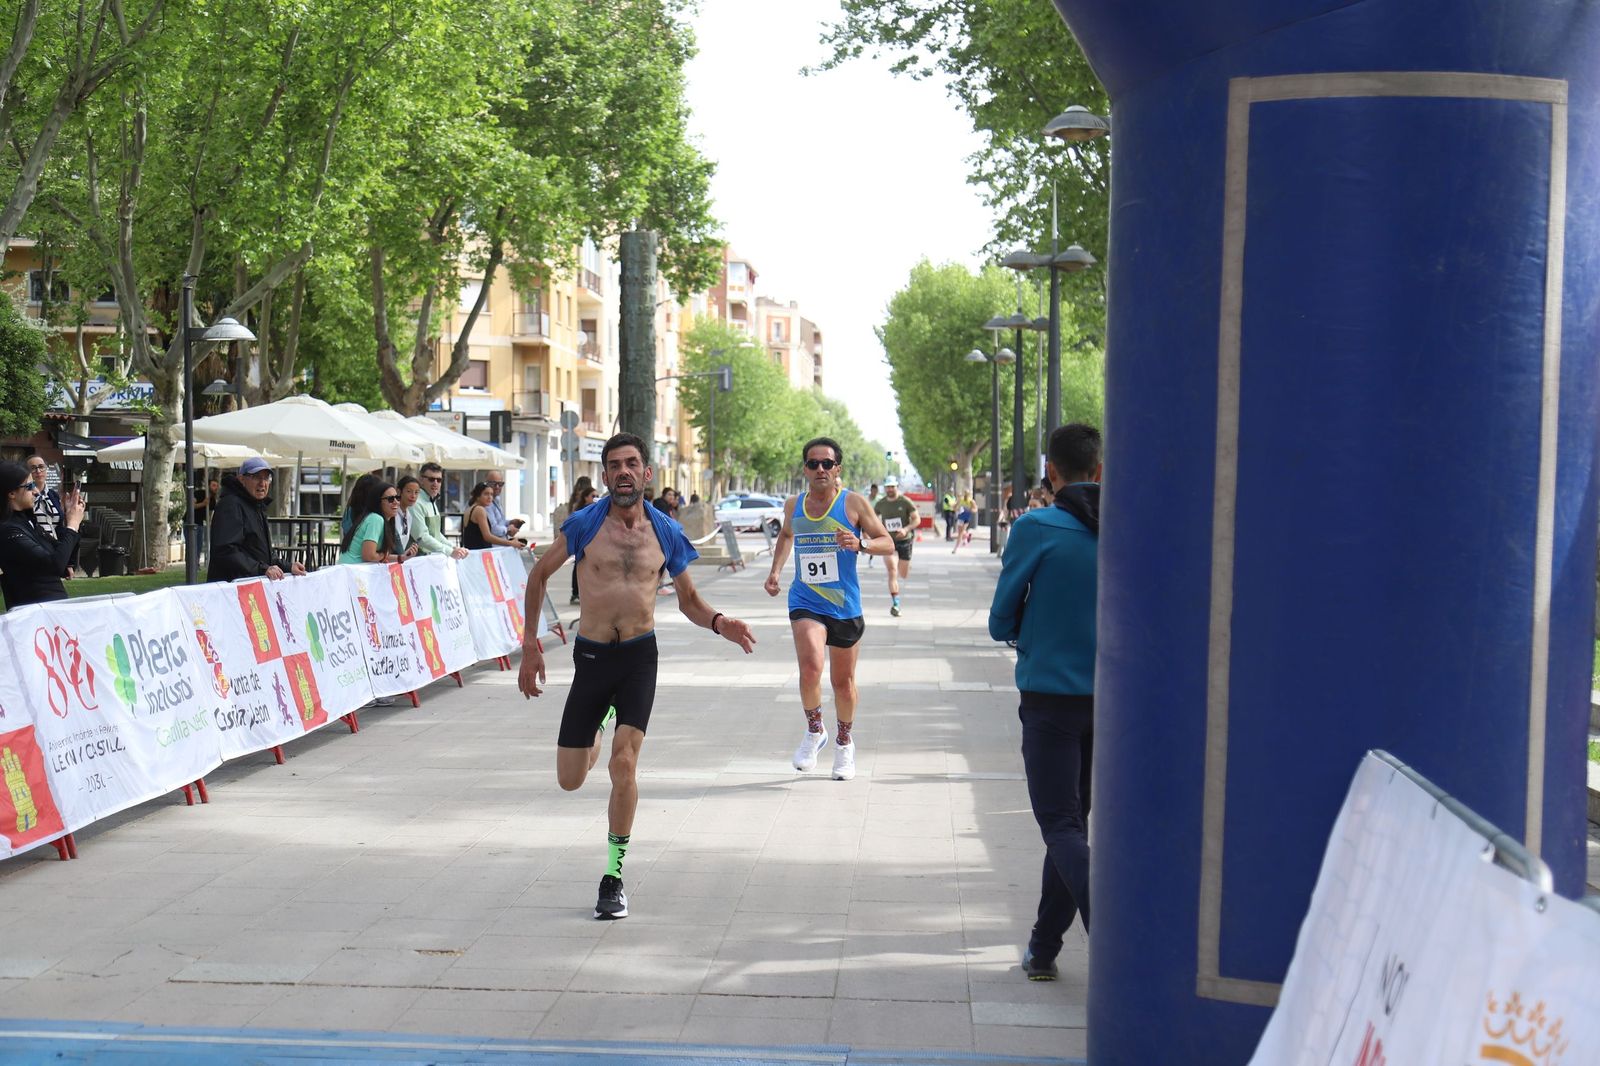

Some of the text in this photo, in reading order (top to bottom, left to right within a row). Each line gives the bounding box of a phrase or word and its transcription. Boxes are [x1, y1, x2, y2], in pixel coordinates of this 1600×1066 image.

[329, 440, 356, 450] Mahou
[808, 561, 827, 577] 91
[142, 673, 195, 715] inclusió
[86, 736, 126, 760] CASTILL
